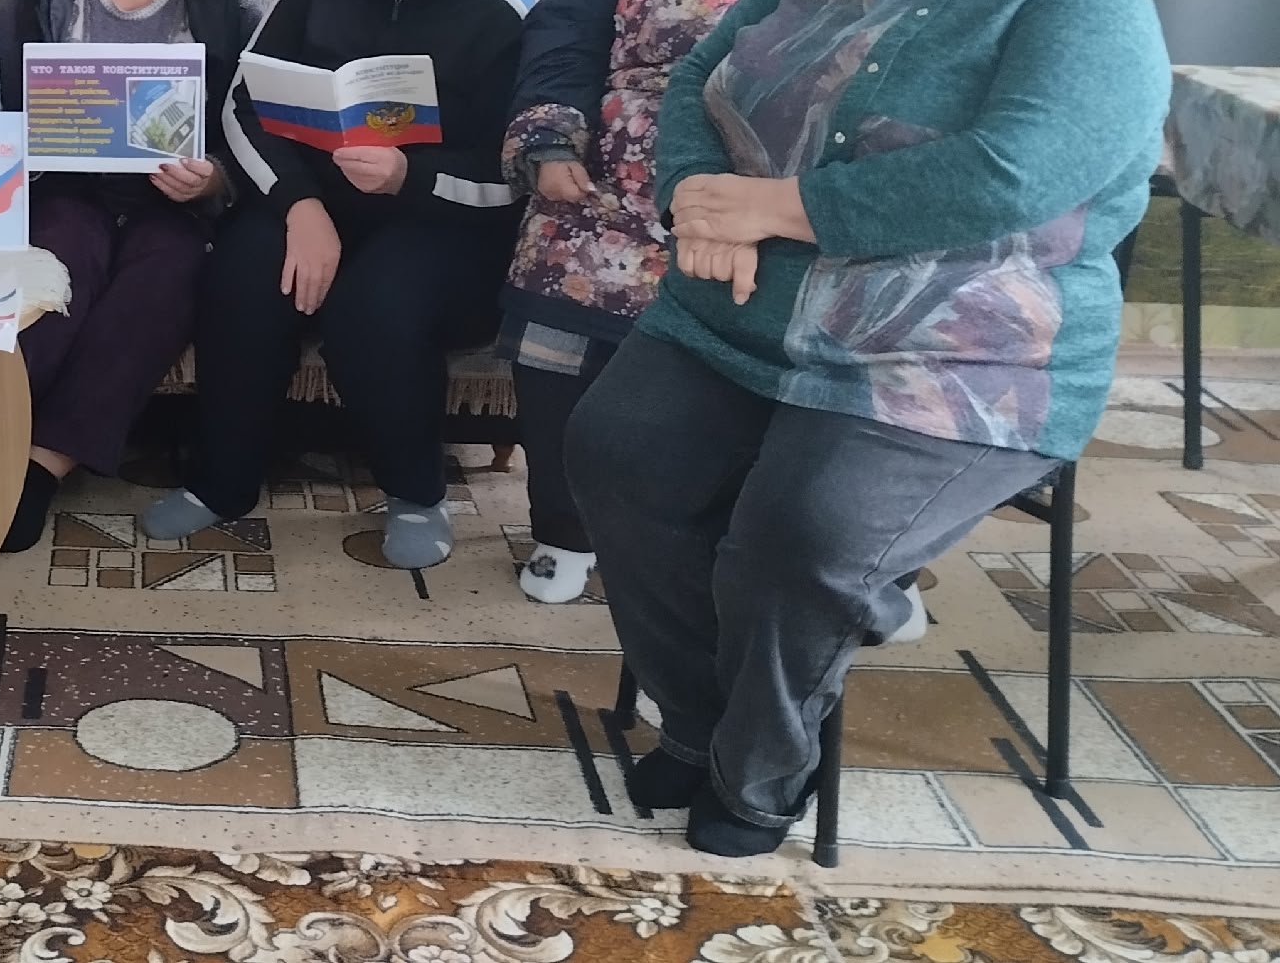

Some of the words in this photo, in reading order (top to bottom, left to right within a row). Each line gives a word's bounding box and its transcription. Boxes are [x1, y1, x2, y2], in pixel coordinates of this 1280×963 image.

[30, 65, 54, 74] ЧТО
[59, 65, 96, 74] ТАКОЕ
[102, 65, 189, 75] КОНСТИТУЦИЯ?
